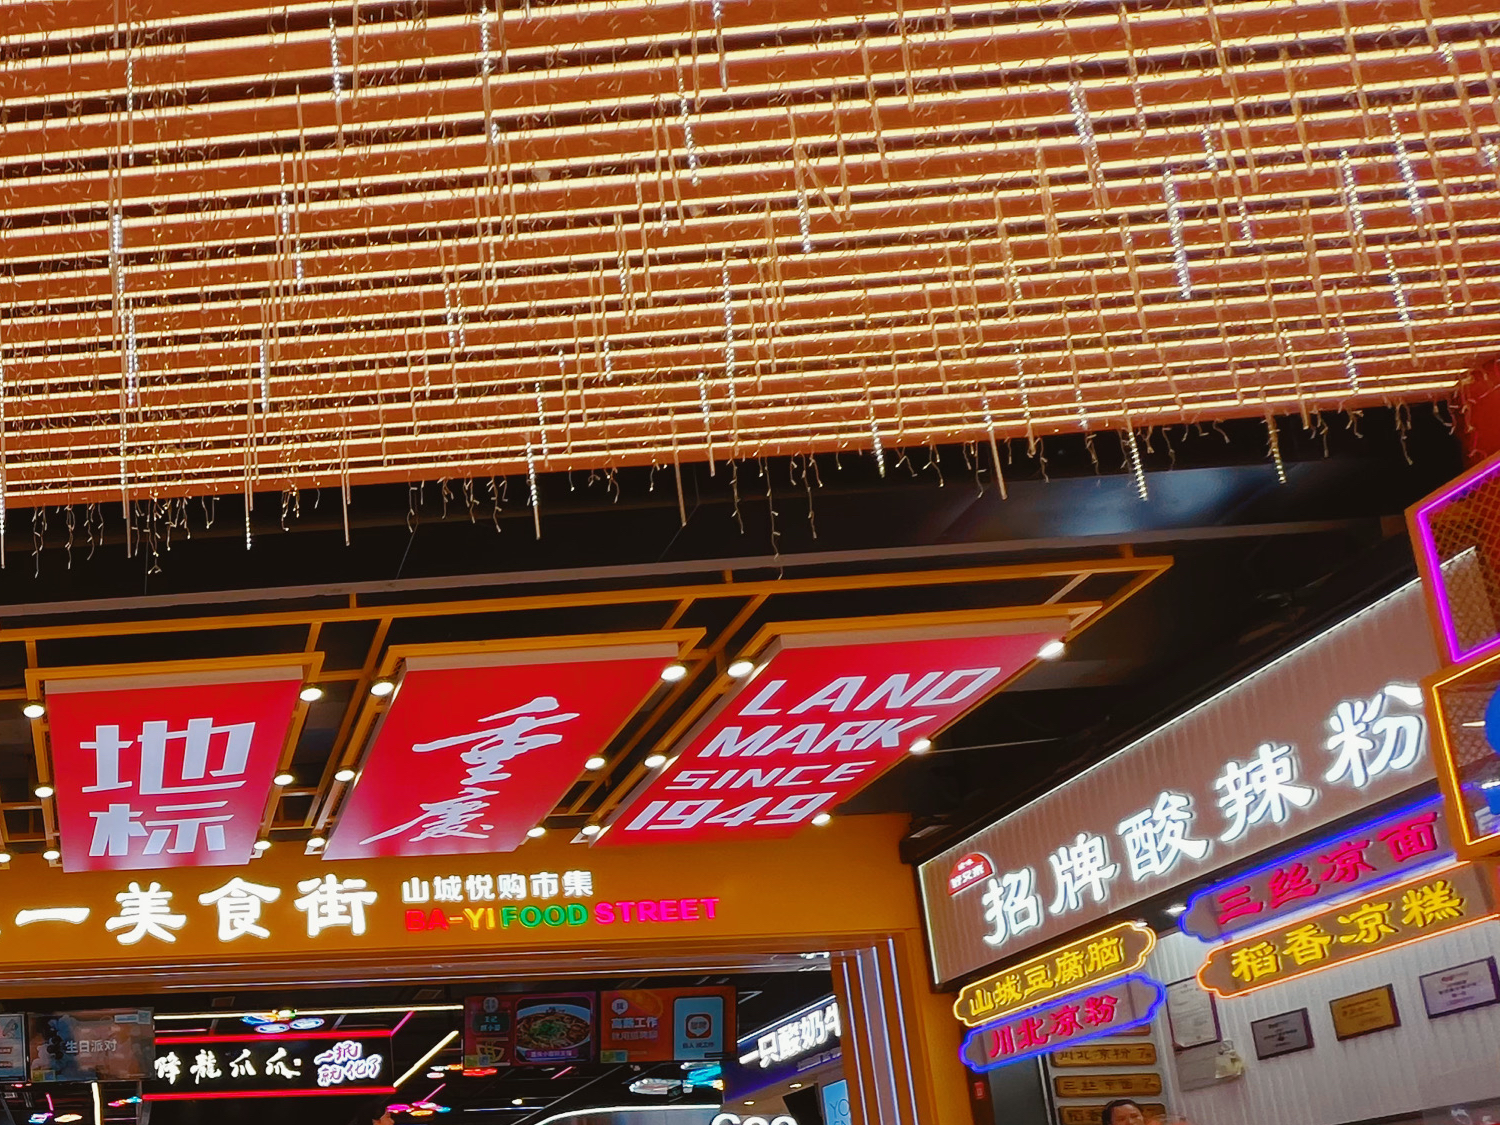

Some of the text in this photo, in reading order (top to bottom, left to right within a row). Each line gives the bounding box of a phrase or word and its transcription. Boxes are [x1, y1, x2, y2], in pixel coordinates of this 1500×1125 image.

[737, 666, 1000, 716] LAND
[698, 715, 937, 758] MARK
[80, 717, 256, 857] 地标
[664, 760, 876, 790] SINCE
[624, 793, 838, 832] 1949
[981, 682, 1425, 947] 招牌酸辣粉
[401, 870, 594, 903] 山城悦购市集
[1217, 812, 1438, 926] 三丝凉面
[405, 897, 720, 933] BA-YI FOOD STREET
[1231, 880, 1464, 982] 稻香凉糕
[969, 936, 1124, 1017] 山城豆腐脑
[65, 1038, 118, 1055] 生日派对
[988, 994, 1119, 1059] 川北凉粉
